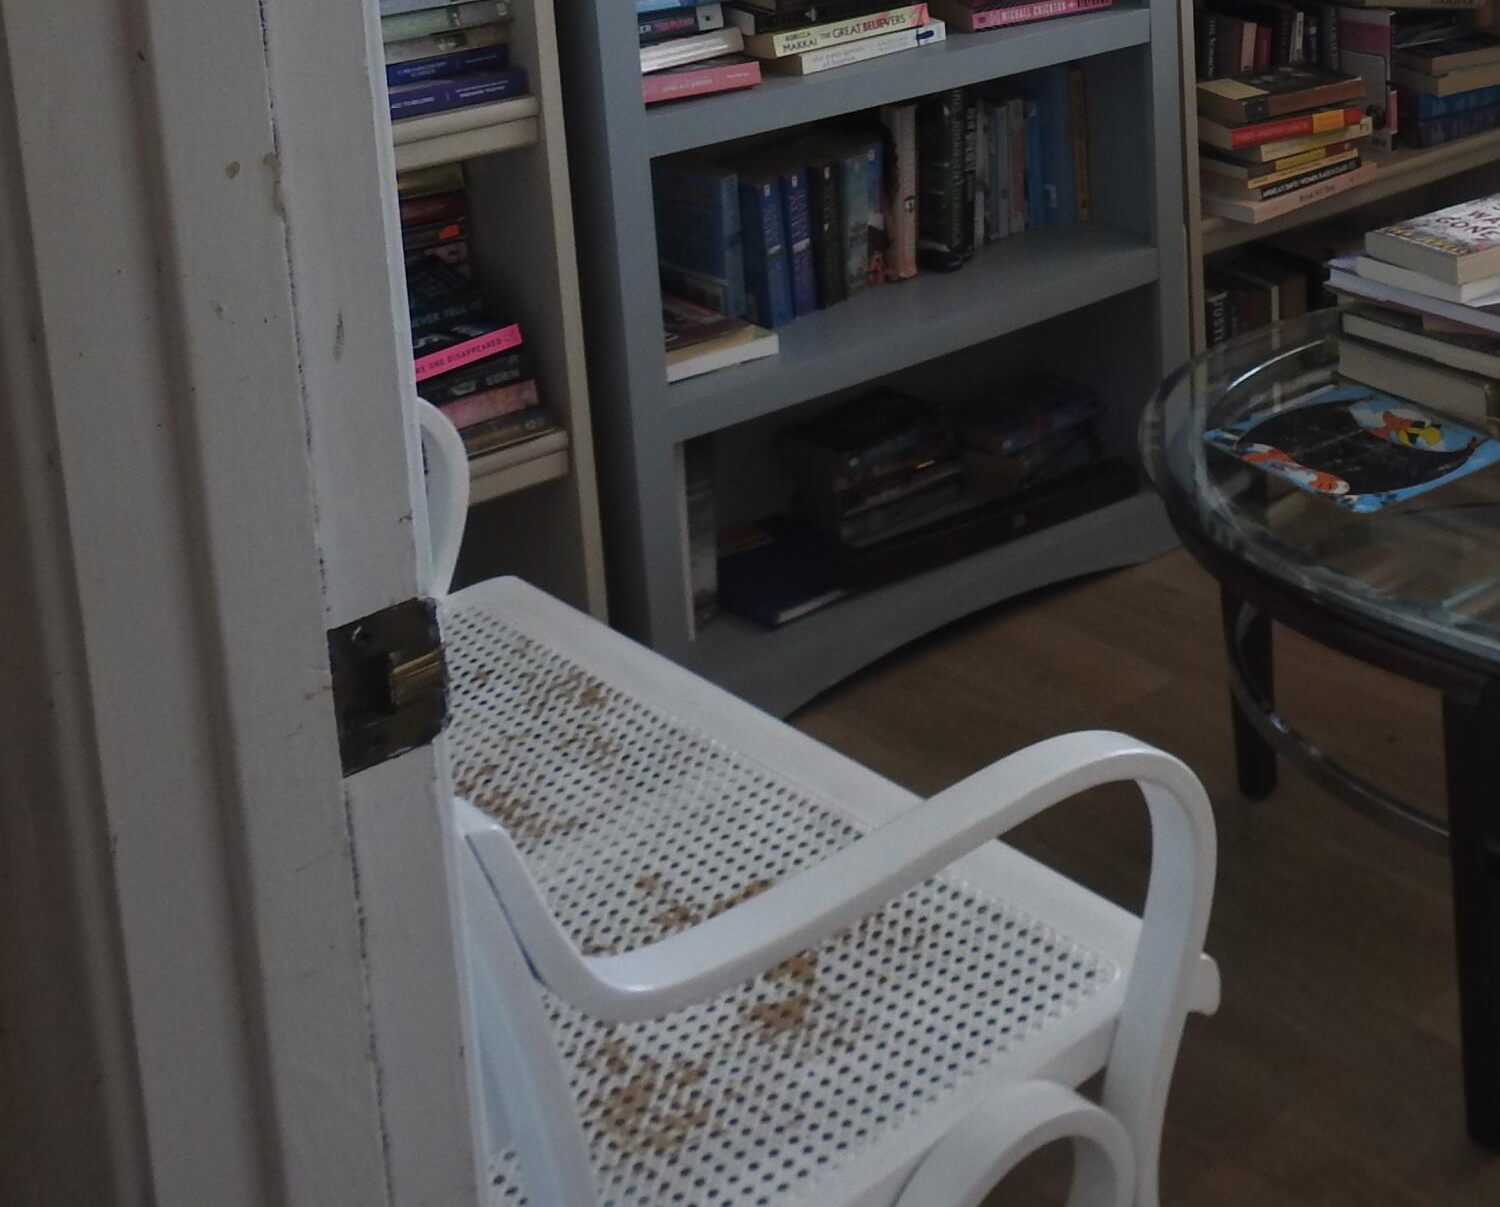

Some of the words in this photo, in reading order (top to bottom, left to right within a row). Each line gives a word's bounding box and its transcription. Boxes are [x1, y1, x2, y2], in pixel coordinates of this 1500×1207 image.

[1001, 5, 1032, 21] MICHAEL
[1032, 1, 1066, 16] CRICHTON
[783, 39, 818, 53] MAKKAI
[819, 31, 831, 40] THE
[832, 23, 862, 39] GREAT
[863, 14, 906, 33] BELIEVERS
[785, 31, 811, 42] REBECCA
